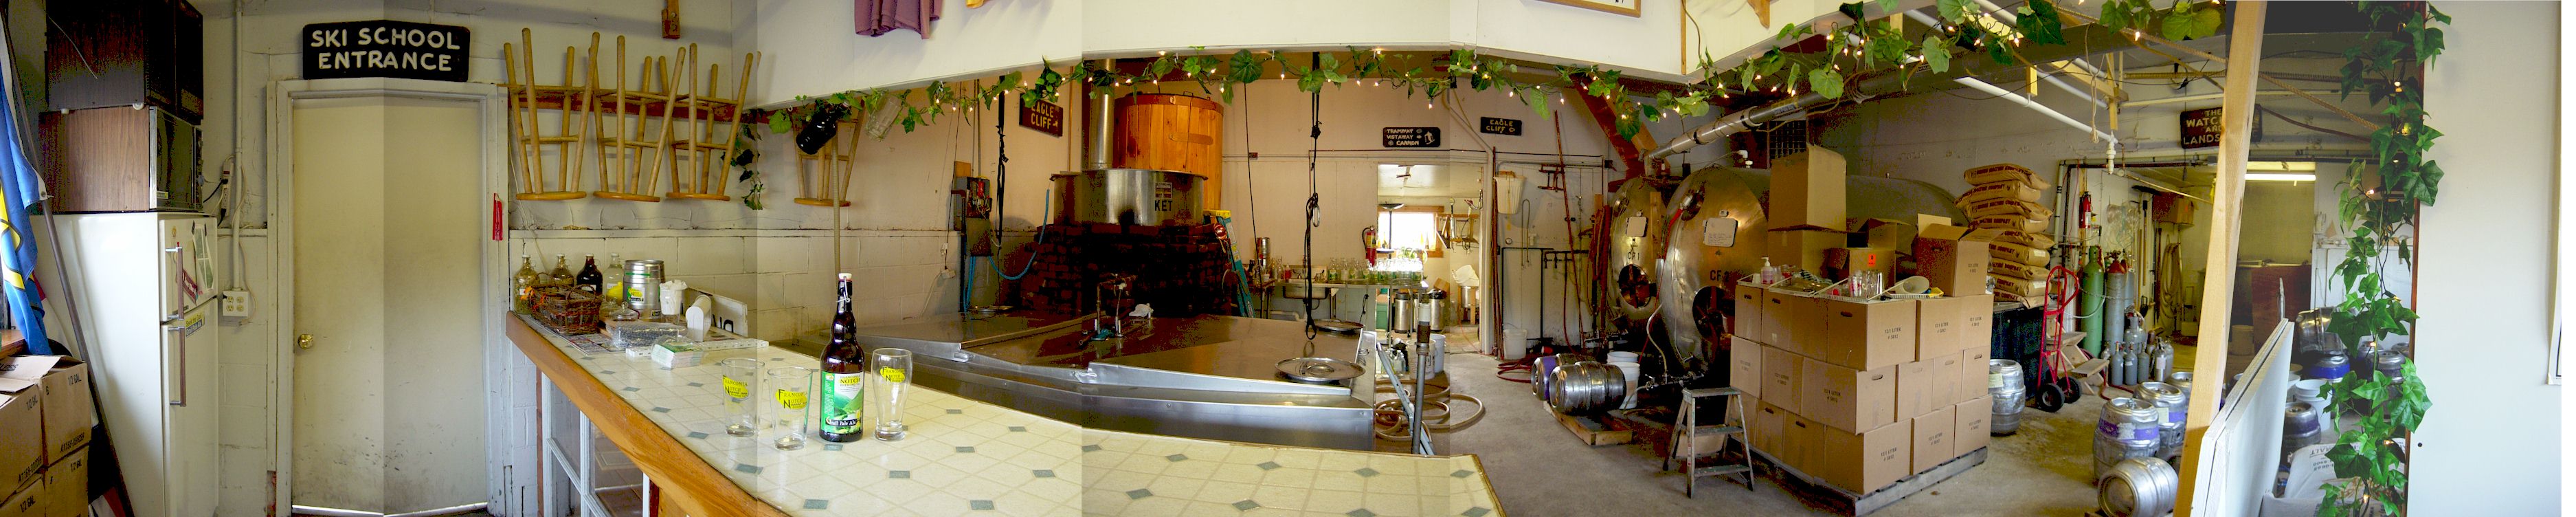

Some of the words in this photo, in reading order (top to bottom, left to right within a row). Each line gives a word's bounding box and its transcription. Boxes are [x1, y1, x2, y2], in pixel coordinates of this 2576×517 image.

[311, 29, 347, 47] SKI
[358, 27, 460, 50] SCHOOL
[318, 50, 451, 71] ENTRANCE
[1031, 113, 1051, 129] CLIFF
[1155, 200, 1172, 211] KET
[1710, 270, 1722, 281] CF
[784, 399, 803, 409] NOTCH
